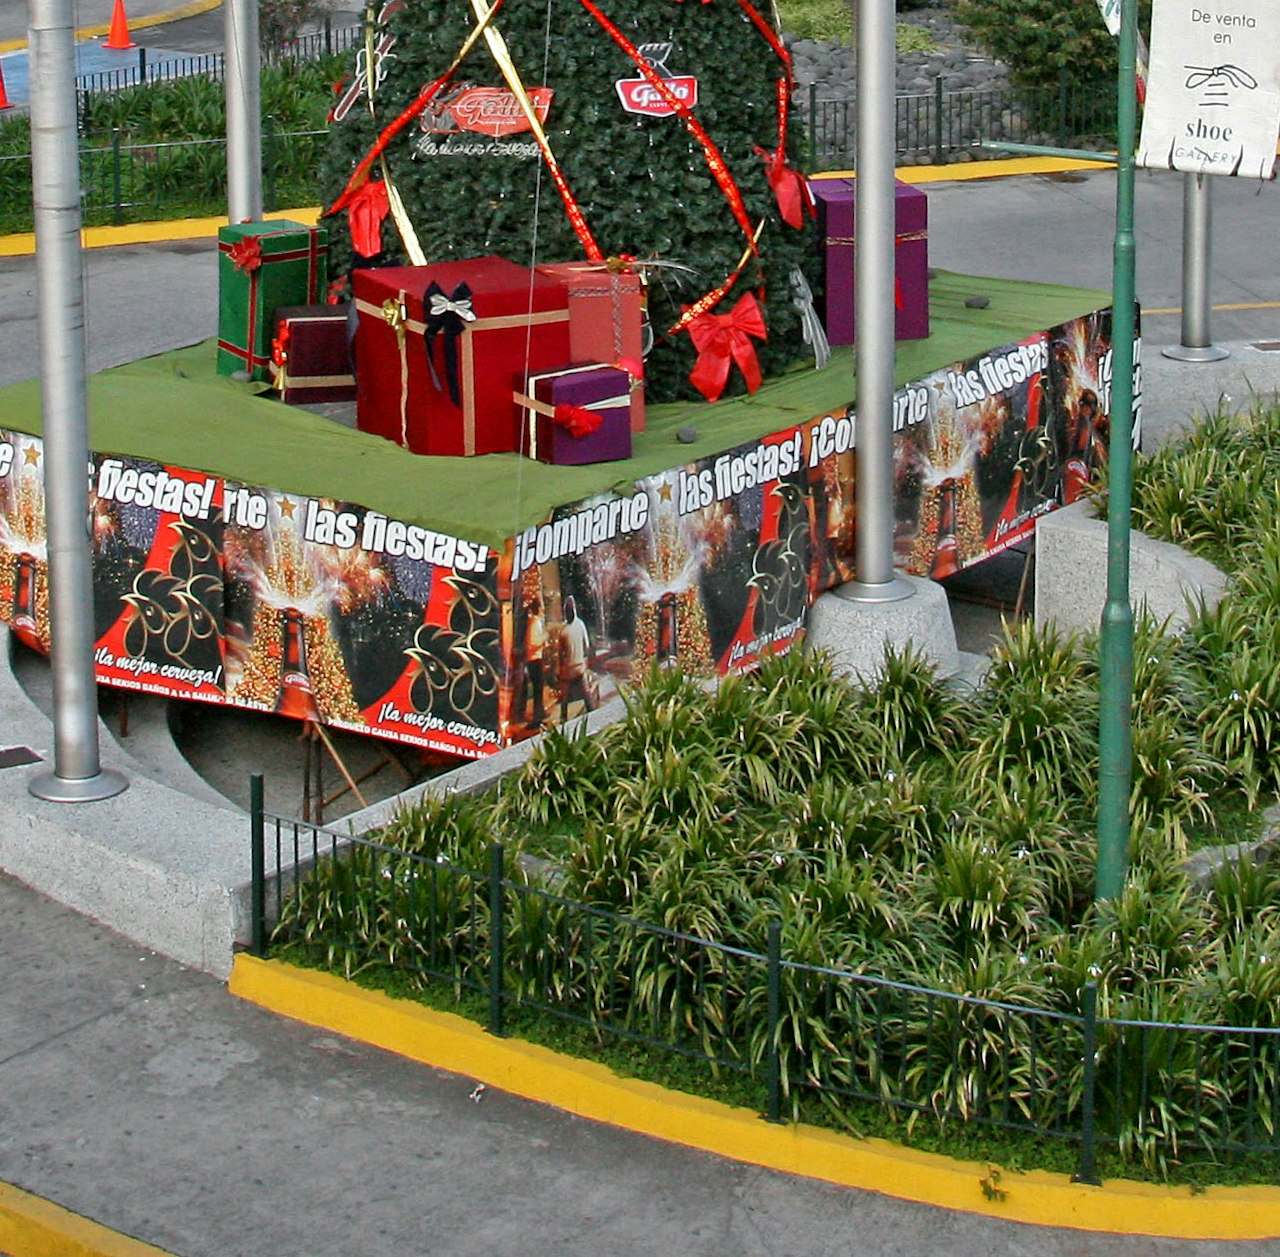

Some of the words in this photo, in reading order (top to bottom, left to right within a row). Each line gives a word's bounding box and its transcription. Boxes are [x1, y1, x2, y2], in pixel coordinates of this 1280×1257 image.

[1191, 9, 1212, 23] De
[1215, 12, 1257, 28] venta
[1213, 33, 1232, 45] en
[457, 92, 526, 125] Gall
[631, 82, 689, 107] Galo
[1185, 117, 1233, 142] shoe
[947, 369, 984, 411] las
[96, 458, 217, 520] fiestas!
[679, 468, 713, 516] las
[714, 431, 803, 502] fiestas!
[304, 498, 358, 549] las
[361, 509, 490, 573] fiestas!
[510, 491, 650, 580] ¡Comparte
[115, 655, 160, 678] mejor
[160, 664, 223, 688] cerveza!
[179, 689, 192, 699] LA
[378, 702, 401, 723] ¡la
[403, 710, 446, 732] mejor
[371, 727, 399, 740] CAUSA
[456, 746, 464, 755] A
[464, 747, 476, 757] LA
